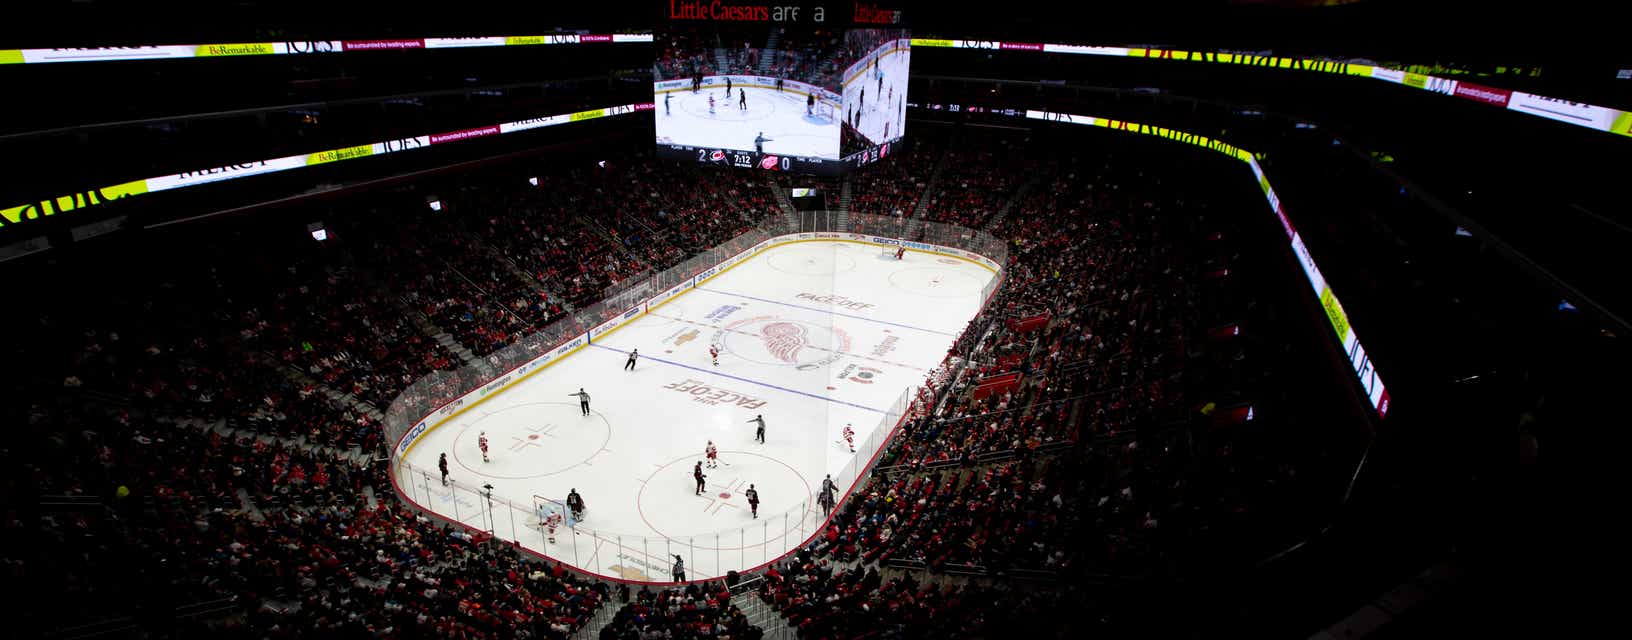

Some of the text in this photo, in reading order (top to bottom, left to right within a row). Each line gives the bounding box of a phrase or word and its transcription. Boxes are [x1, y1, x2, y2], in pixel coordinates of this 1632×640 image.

[670, 0, 708, 19] Little
[710, 0, 769, 21] Caesars
[699, 149, 706, 162] 2
[734, 154, 751, 164] 7:12
[782, 157, 790, 170] 0
[873, 237, 900, 246] GEICO
[663, 381, 768, 409] FACE-OFF
[400, 421, 427, 452] GEICO
